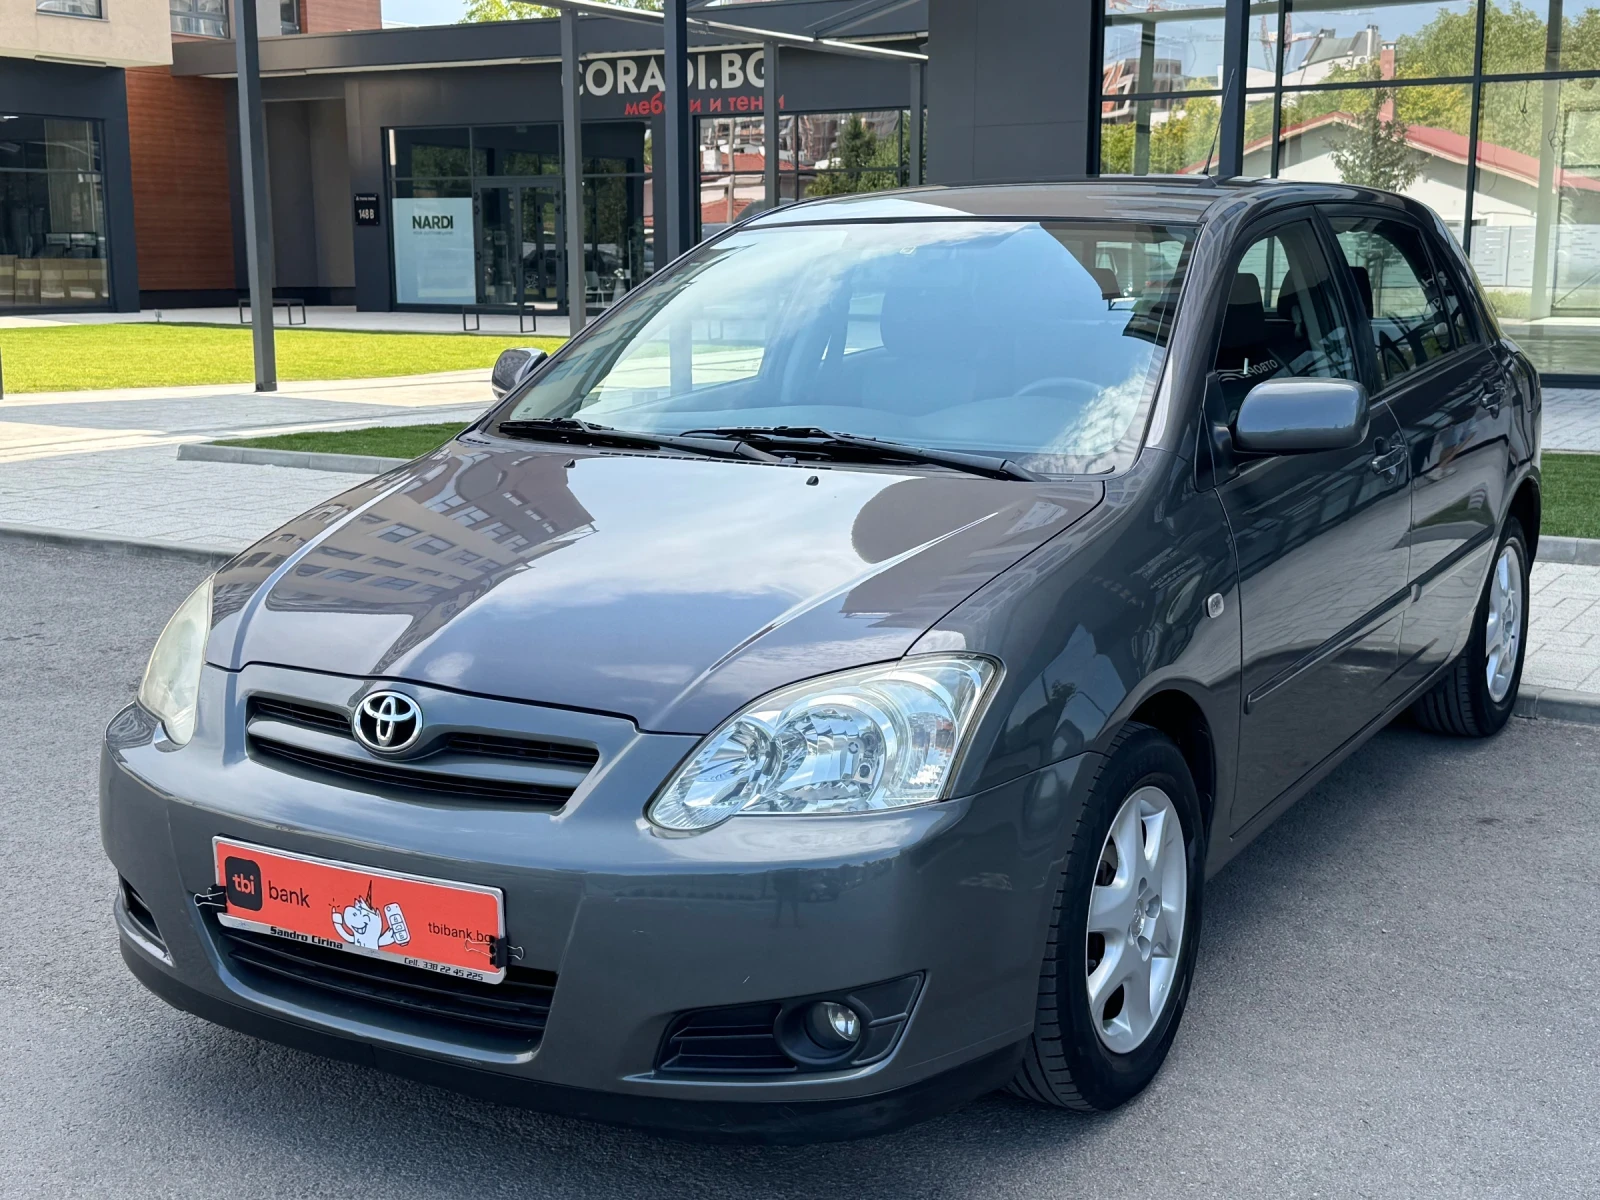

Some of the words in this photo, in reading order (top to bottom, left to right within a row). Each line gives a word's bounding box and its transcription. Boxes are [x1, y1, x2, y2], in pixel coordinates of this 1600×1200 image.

[624, 91, 702, 115] меби
[709, 97, 722, 112] и
[412, 215, 454, 229] NARDI
[232, 873, 255, 895] tbi
[268, 880, 310, 908] bank
[270, 926, 308, 942] Sandro
[311, 935, 344, 950] Cirina
[404, 957, 421, 968] Cell.
[440, 965, 451, 974] 22
[452, 968, 465, 977] 45
[466, 971, 484, 981] 225
